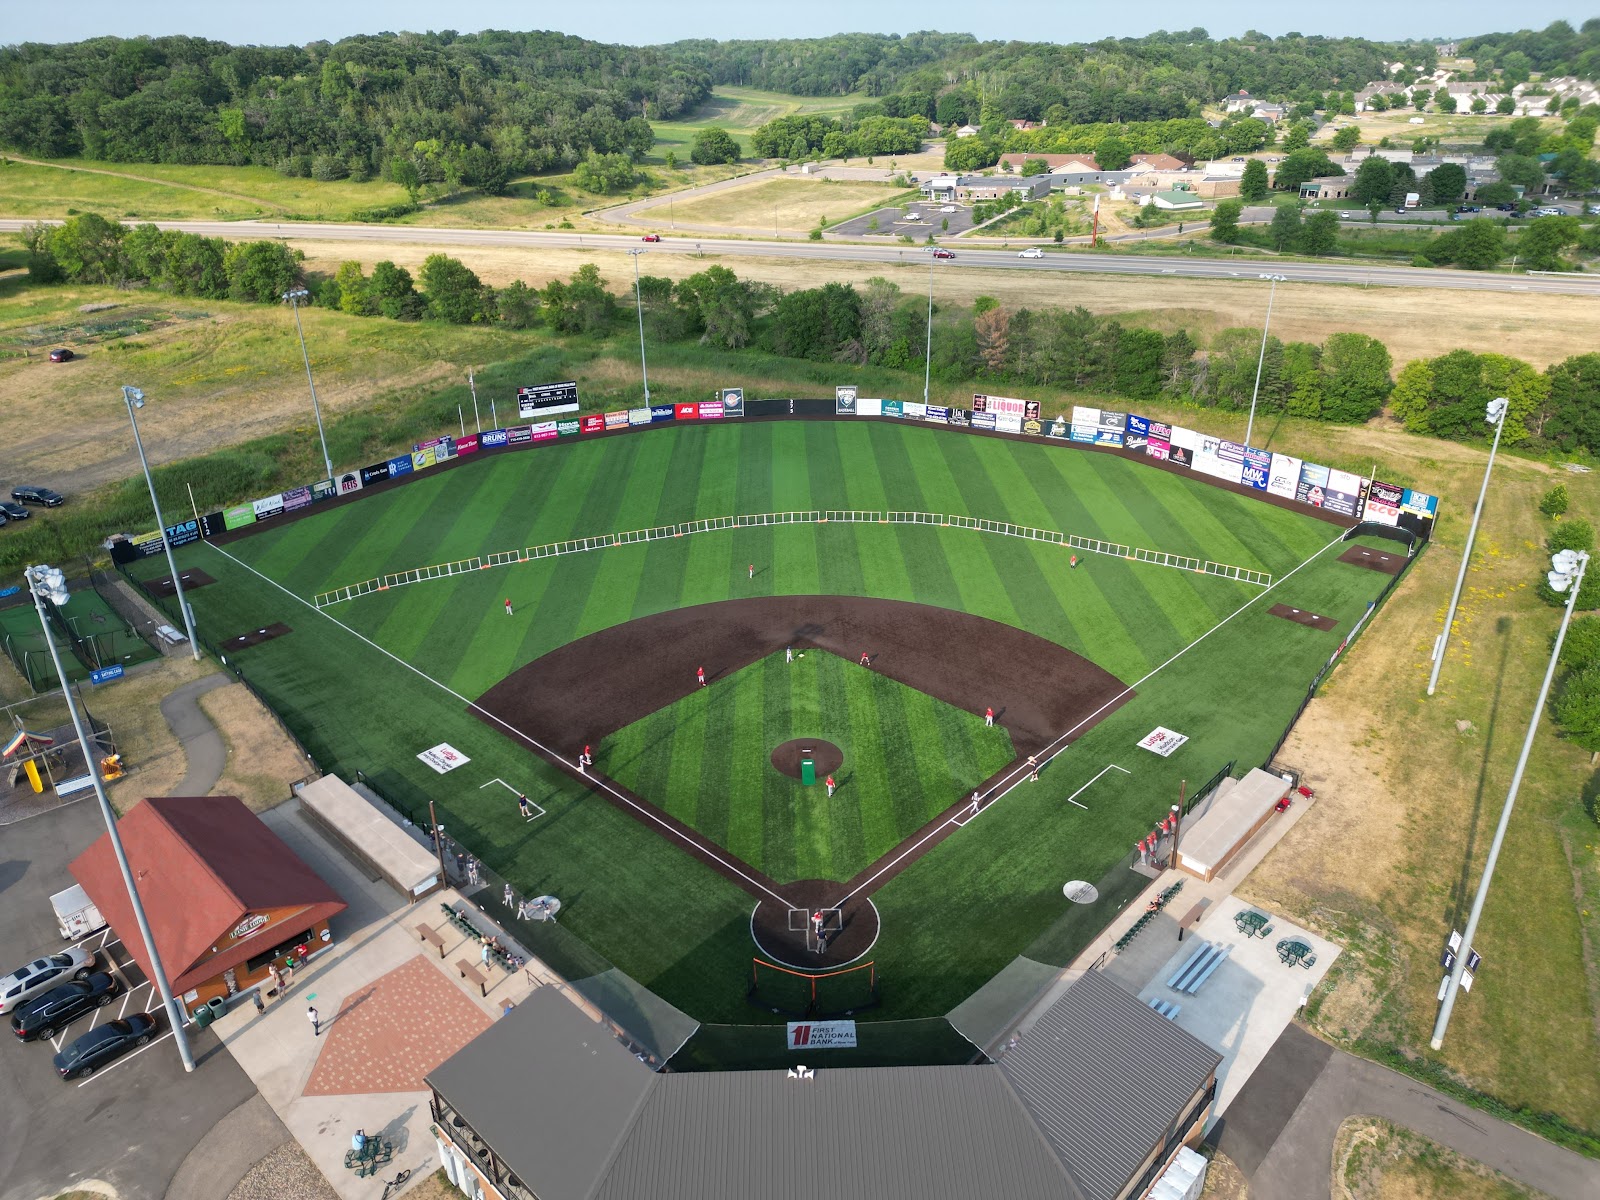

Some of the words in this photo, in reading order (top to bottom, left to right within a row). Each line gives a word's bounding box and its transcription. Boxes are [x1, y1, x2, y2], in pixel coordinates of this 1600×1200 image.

[992, 401, 1025, 413] LIQUOR
[483, 433, 506, 443] BRUNS
[1243, 467, 1266, 487] MWC
[342, 480, 358, 491] REIS
[166, 521, 196, 535] TAG
